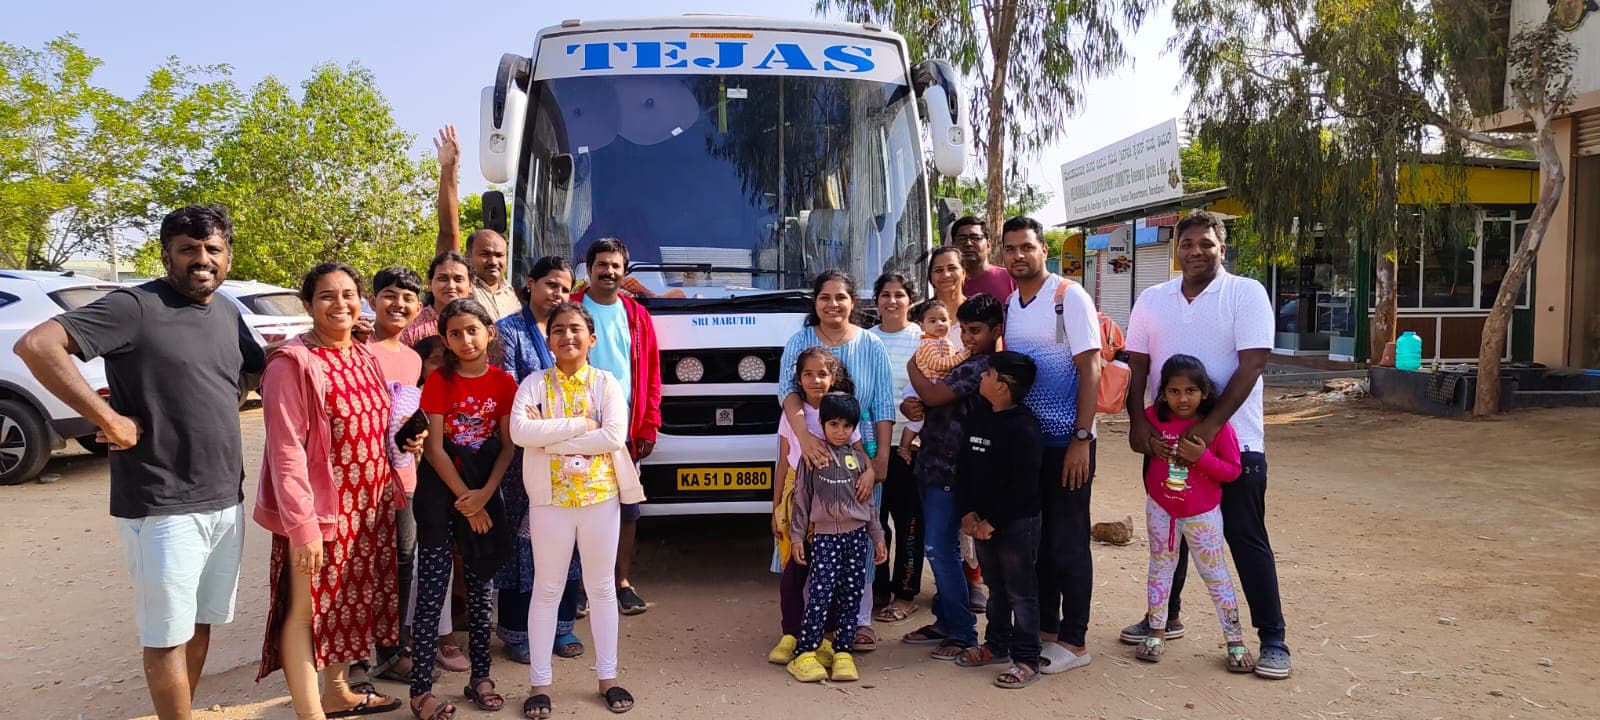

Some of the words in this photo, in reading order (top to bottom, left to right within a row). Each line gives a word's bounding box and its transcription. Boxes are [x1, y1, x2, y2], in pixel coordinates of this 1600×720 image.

[567, 41, 875, 73] TEJAS
[692, 317, 708, 326] SRI
[712, 316, 756, 325] MARUTHI
[681, 473, 700, 486] KA
[704, 472, 718, 486] 51
[724, 472, 732, 485] D
[736, 471, 767, 485] 8880
